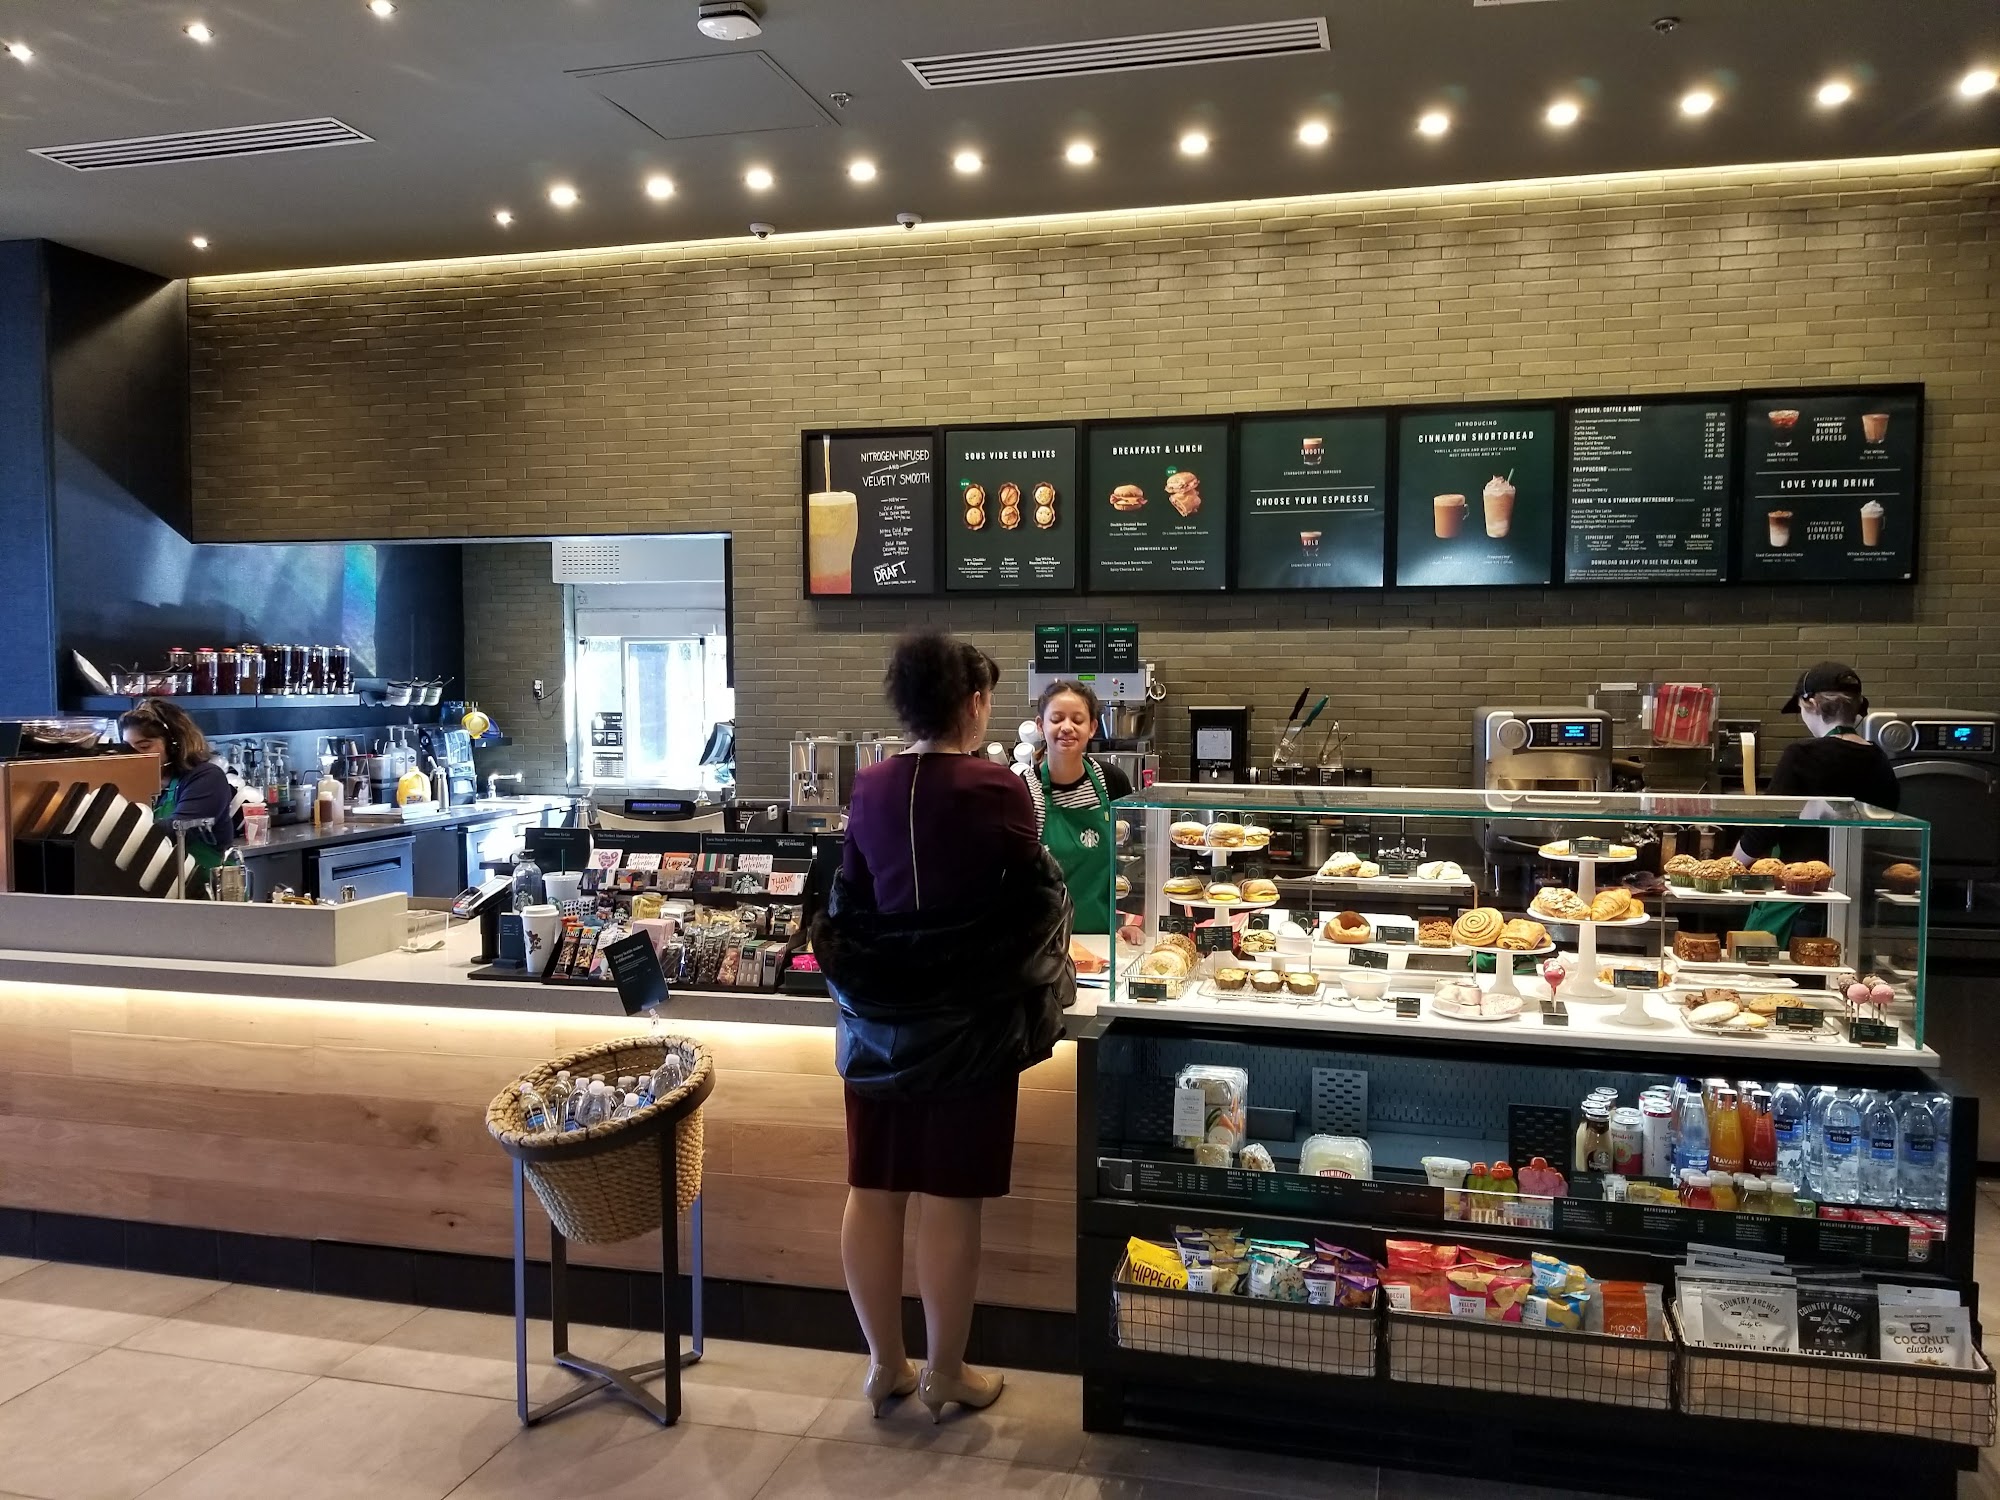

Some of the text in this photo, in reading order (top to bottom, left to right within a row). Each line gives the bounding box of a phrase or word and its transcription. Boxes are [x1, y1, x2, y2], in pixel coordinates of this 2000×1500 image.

[1575, 406, 1601, 414] ESPRESSO,
[1455, 420, 1497, 428] INTRODUCING
[1418, 430, 1534, 444] CINNAMON SHORTBREAD
[1812, 434, 1847, 442] ESPRESSO
[965, 450, 1056, 460] SOUS VIDE EGG BITES
[1113, 446, 1161, 455] BREAKFAST
[1175, 445, 1203, 453] LUNCH
[1301, 448, 1325, 456] SMOOTH
[861, 449, 929, 462] NITROGEN-INFUSED
[862, 473, 930, 487] VELVETY SMOOTH
[1781, 478, 1875, 488] LOVE YOUR DRINK
[1256, 494, 1370, 506] CHOOSE YOUR ESPRESSO
[874, 560, 906, 583] DRAFT
[771, 875, 794, 885] THANK
[581, 931, 596, 939] KIND
[1833, 1134, 1849, 1142] ethos
[1712, 1156, 1742, 1165] TEAVANA
[1132, 1262, 1179, 1290] HIPPEAS
[1719, 1297, 1780, 1315] COUNTRY ARCHER
[1798, 1302, 1861, 1322] COUNTRY ARCHER
[1610, 1324, 1641, 1333] MOON
[1893, 1336, 1950, 1344] COCONUT
[1906, 1345, 1944, 1354] clusters
